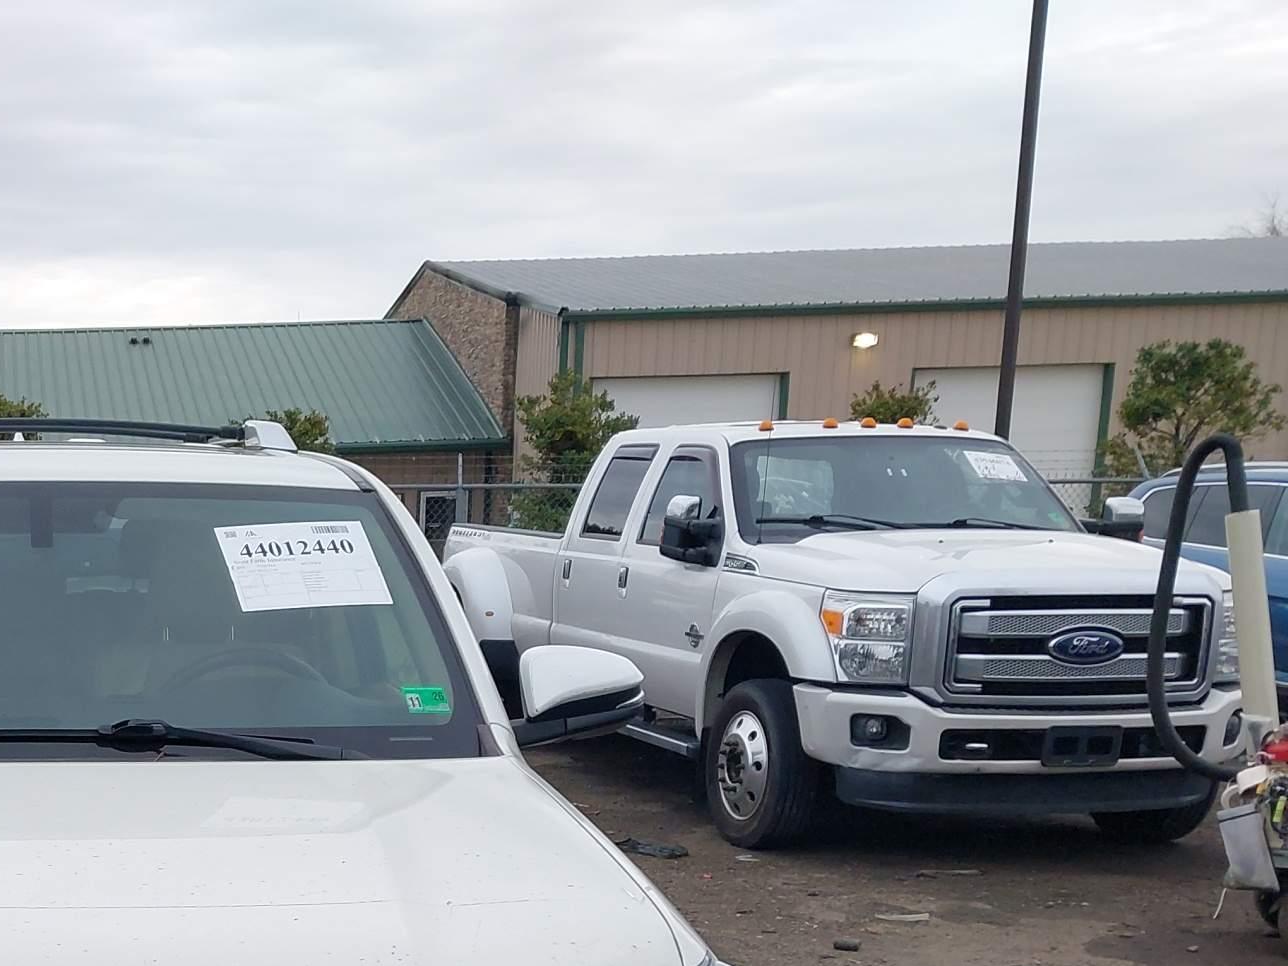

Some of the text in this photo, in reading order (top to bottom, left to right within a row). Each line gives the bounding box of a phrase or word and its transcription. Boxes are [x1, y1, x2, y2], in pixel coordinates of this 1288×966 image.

[240, 538, 355, 558] 44012440
[1068, 636, 1110, 654] Ford
[407, 696, 422, 708] 11
[432, 691, 445, 701] 26
